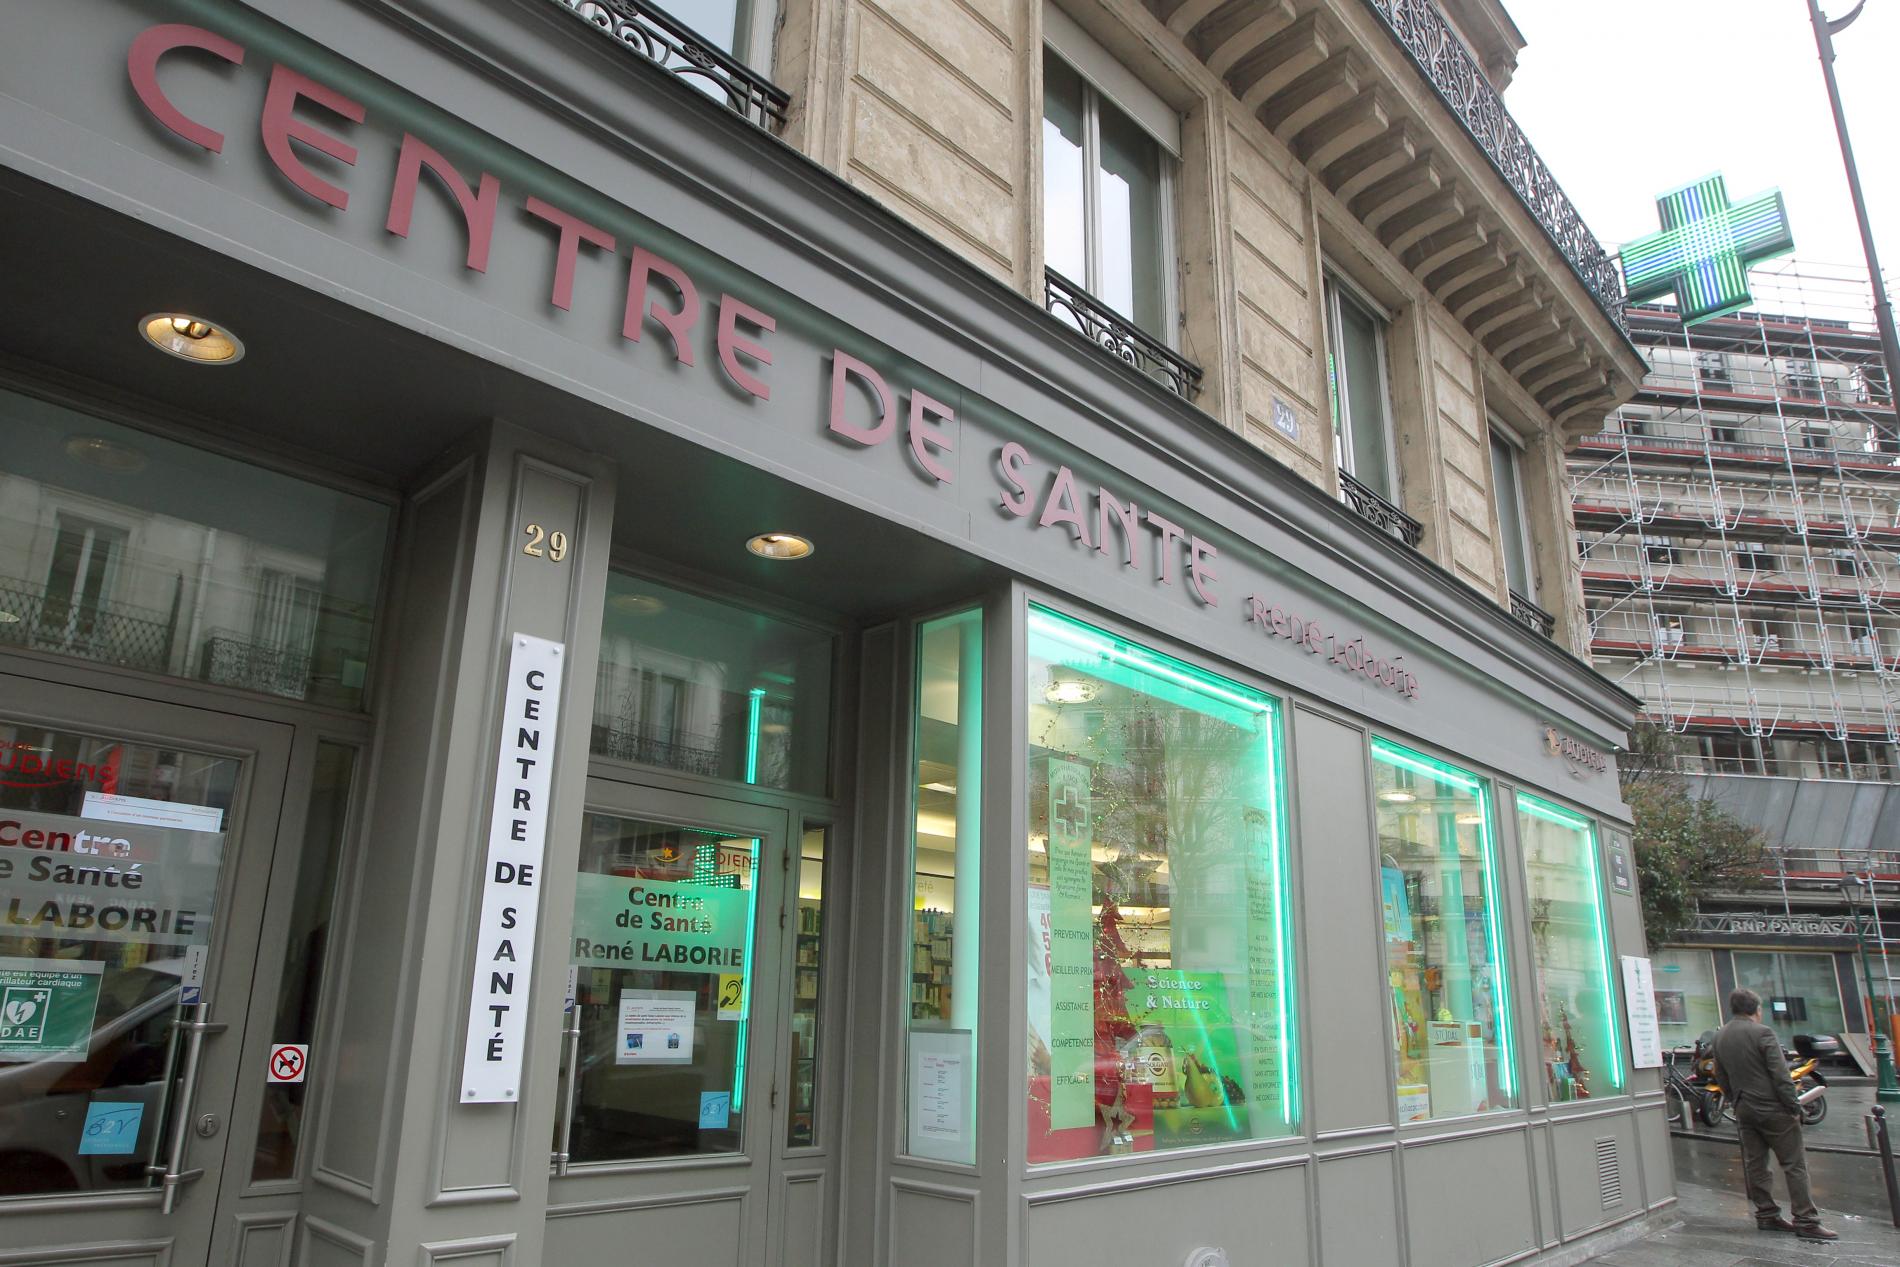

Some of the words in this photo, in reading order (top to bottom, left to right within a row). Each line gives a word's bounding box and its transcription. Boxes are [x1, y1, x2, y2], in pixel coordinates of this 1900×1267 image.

[127, 23, 776, 400] CENTRE
[830, 348, 954, 484] DE
[1000, 441, 1218, 608] SANTE
[1276, 403, 1295, 433] 29
[523, 524, 568, 562] 29
[510, 670, 545, 842] CENTRE
[28, 854, 144, 890] Santé
[494, 861, 534, 886] DE
[7, 898, 197, 936] LABORIE
[615, 908, 643, 929] de
[1053, 928, 1090, 940] PREVENTION
[574, 938, 634, 961] René
[641, 942, 743, 967] LABORIE
[486, 907, 518, 1062] SANTÉ
[1147, 974, 1202, 991] Science
[1055, 1001, 1089, 1011] ASSISTANCE
[1146, 993, 1154, 1009] &
[1161, 999, 1210, 1010] Nature
[1, 1027, 39, 1038] DAE
